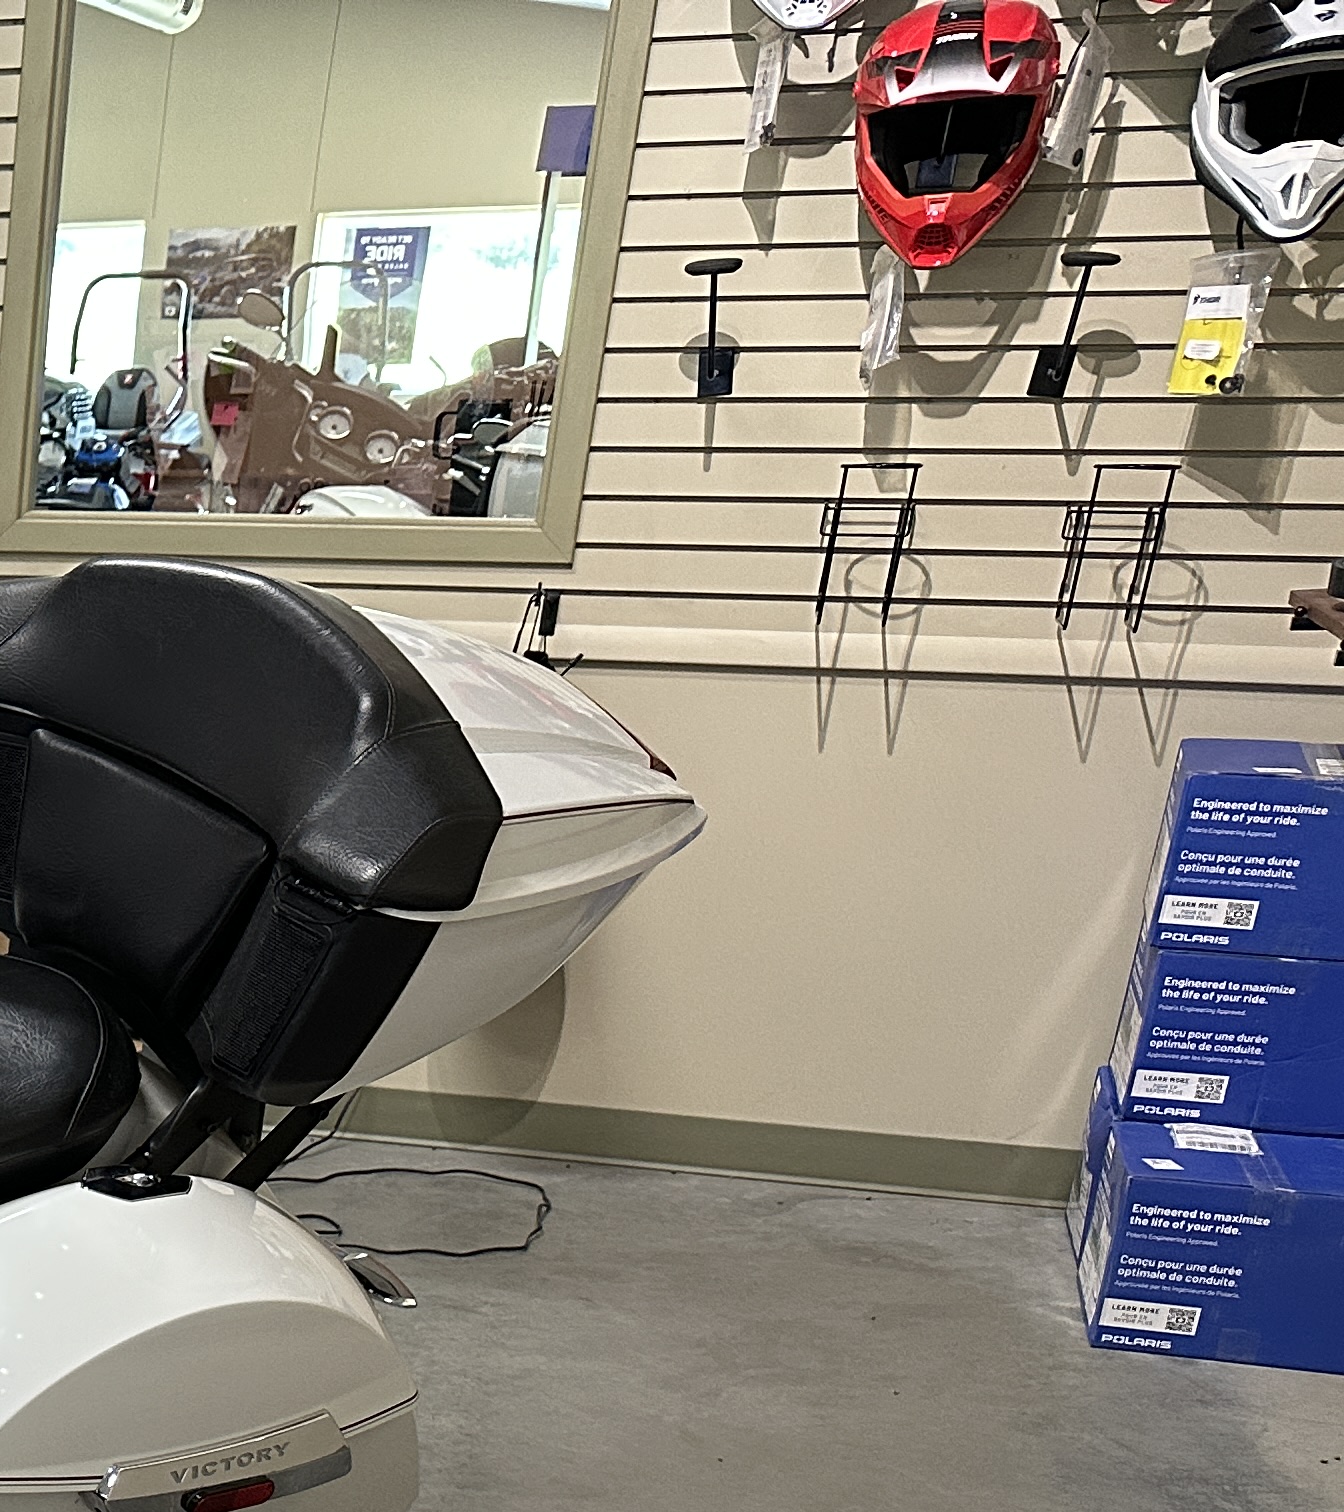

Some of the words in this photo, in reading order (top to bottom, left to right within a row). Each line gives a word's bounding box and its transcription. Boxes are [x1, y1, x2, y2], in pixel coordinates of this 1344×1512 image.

[1193, 798, 1257, 811] Engineered
[1260, 802, 1271, 812] to
[1273, 804, 1328, 816] maximize
[1191, 810, 1210, 820] the
[1211, 811, 1230, 822] life
[1232, 812, 1244, 822] of
[1246, 815, 1272, 825] your
[1274, 815, 1300, 826] ride.
[1180, 850, 1214, 862] Conçu
[1217, 854, 1243, 864] pour
[1244, 856, 1265, 865] une
[1267, 855, 1300, 868] durée
[1178, 862, 1225, 874] optimale
[1228, 865, 1241, 875] de
[1243, 867, 1296, 880] conduite.
[1160, 932, 1230, 945] POLARIS
[1164, 976, 1227, 990] Engineered
[1229, 981, 1240, 991] to
[1242, 984, 1296, 995] maximize
[1162, 989, 1180, 999] the
[1182, 989, 1200, 1000] life
[1202, 990, 1214, 1001] of
[1216, 993, 1242, 1003] your
[1243, 994, 1269, 1005] ride.
[1152, 1027, 1186, 1039] Conçu
[1187, 1031, 1213, 1041] pour
[1214, 1033, 1235, 1042] une
[1237, 1033, 1269, 1044] durée
[1149, 1039, 1196, 1052] optimale
[1198, 1042, 1212, 1051] de
[1214, 1044, 1264, 1055] conduite.
[1133, 1105, 1201, 1118] POLARIS
[1132, 1204, 1197, 1219] Engineered
[1199, 1210, 1212, 1221] to
[1214, 1213, 1270, 1226] maximize
[1130, 1216, 1149, 1227] the
[1150, 1217, 1170, 1229] life
[1172, 1219, 1185, 1230] of
[1186, 1222, 1214, 1234] your
[1215, 1223, 1242, 1236] ride.
[1120, 1255, 1156, 1268] Conçu
[1157, 1260, 1184, 1272] pour
[1185, 1263, 1207, 1273] une
[1209, 1263, 1243, 1277] durée
[1117, 1268, 1167, 1282] optimale
[1168, 1271, 1183, 1282] de
[1185, 1274, 1239, 1288] conduite.
[1101, 1334, 1172, 1350] POLARIS
[169, 1441, 291, 1485] VICTORY
